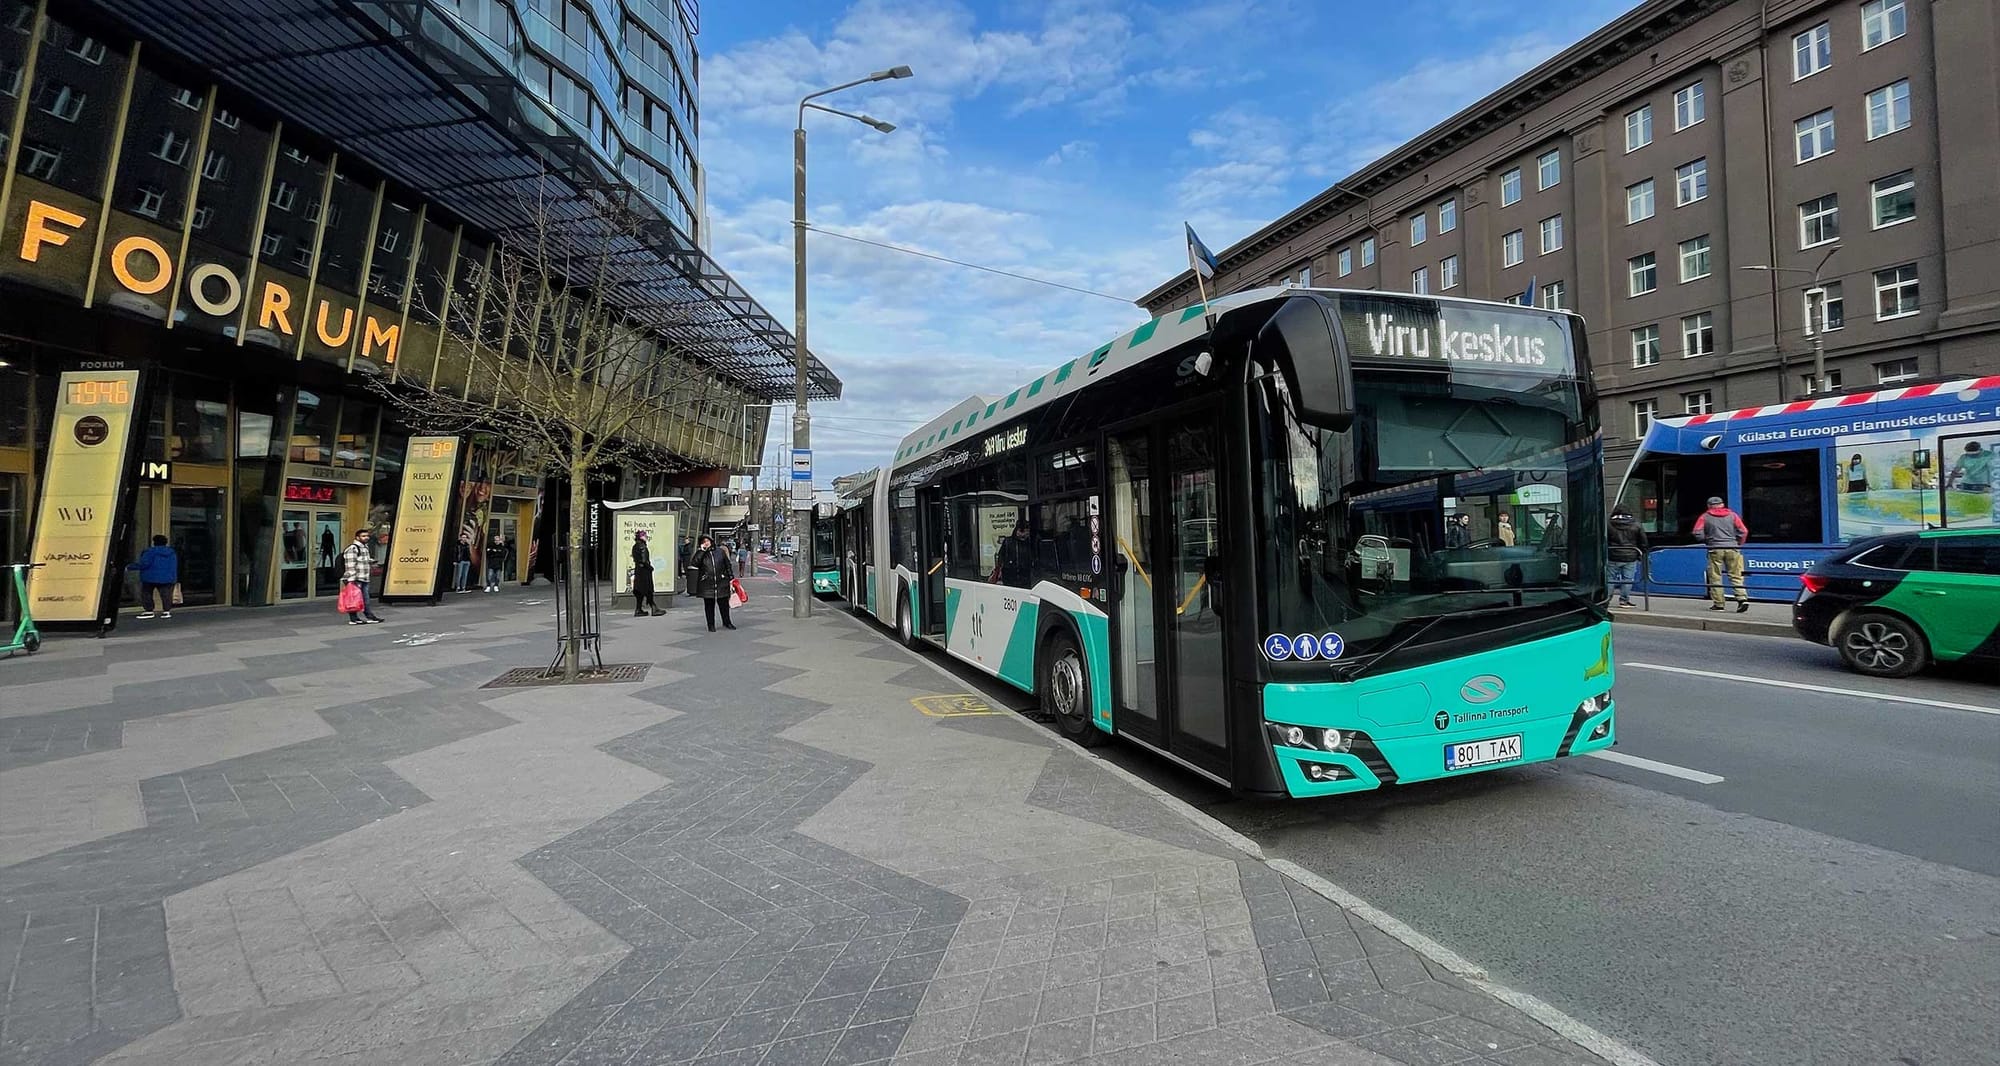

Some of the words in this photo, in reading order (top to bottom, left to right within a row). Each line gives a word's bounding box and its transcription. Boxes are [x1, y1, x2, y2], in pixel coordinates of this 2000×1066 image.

[20, 200, 400, 363] FOORUM
[1366, 312, 1429, 358] Viru
[1439, 319, 1546, 365] keskus
[80, 361, 124, 369] FOORUM
[1738, 431, 1786, 443] Külasta
[1790, 424, 1848, 439] Euroopa
[1853, 409, 1975, 432] Elamuskeskust
[412, 472, 443, 480] REPLAY
[414, 494, 433, 503] NOA
[414, 503, 433, 511] NOA
[43, 552, 91, 561] VAPIANO
[1748, 560, 1799, 570] Euroopa
[1004, 597, 1018, 612] 2801
[1453, 712, 1487, 724] Tallinna
[1489, 705, 1529, 719] Transport
[1458, 744, 1481, 763] 801
[1490, 739, 1517, 758] TAK
